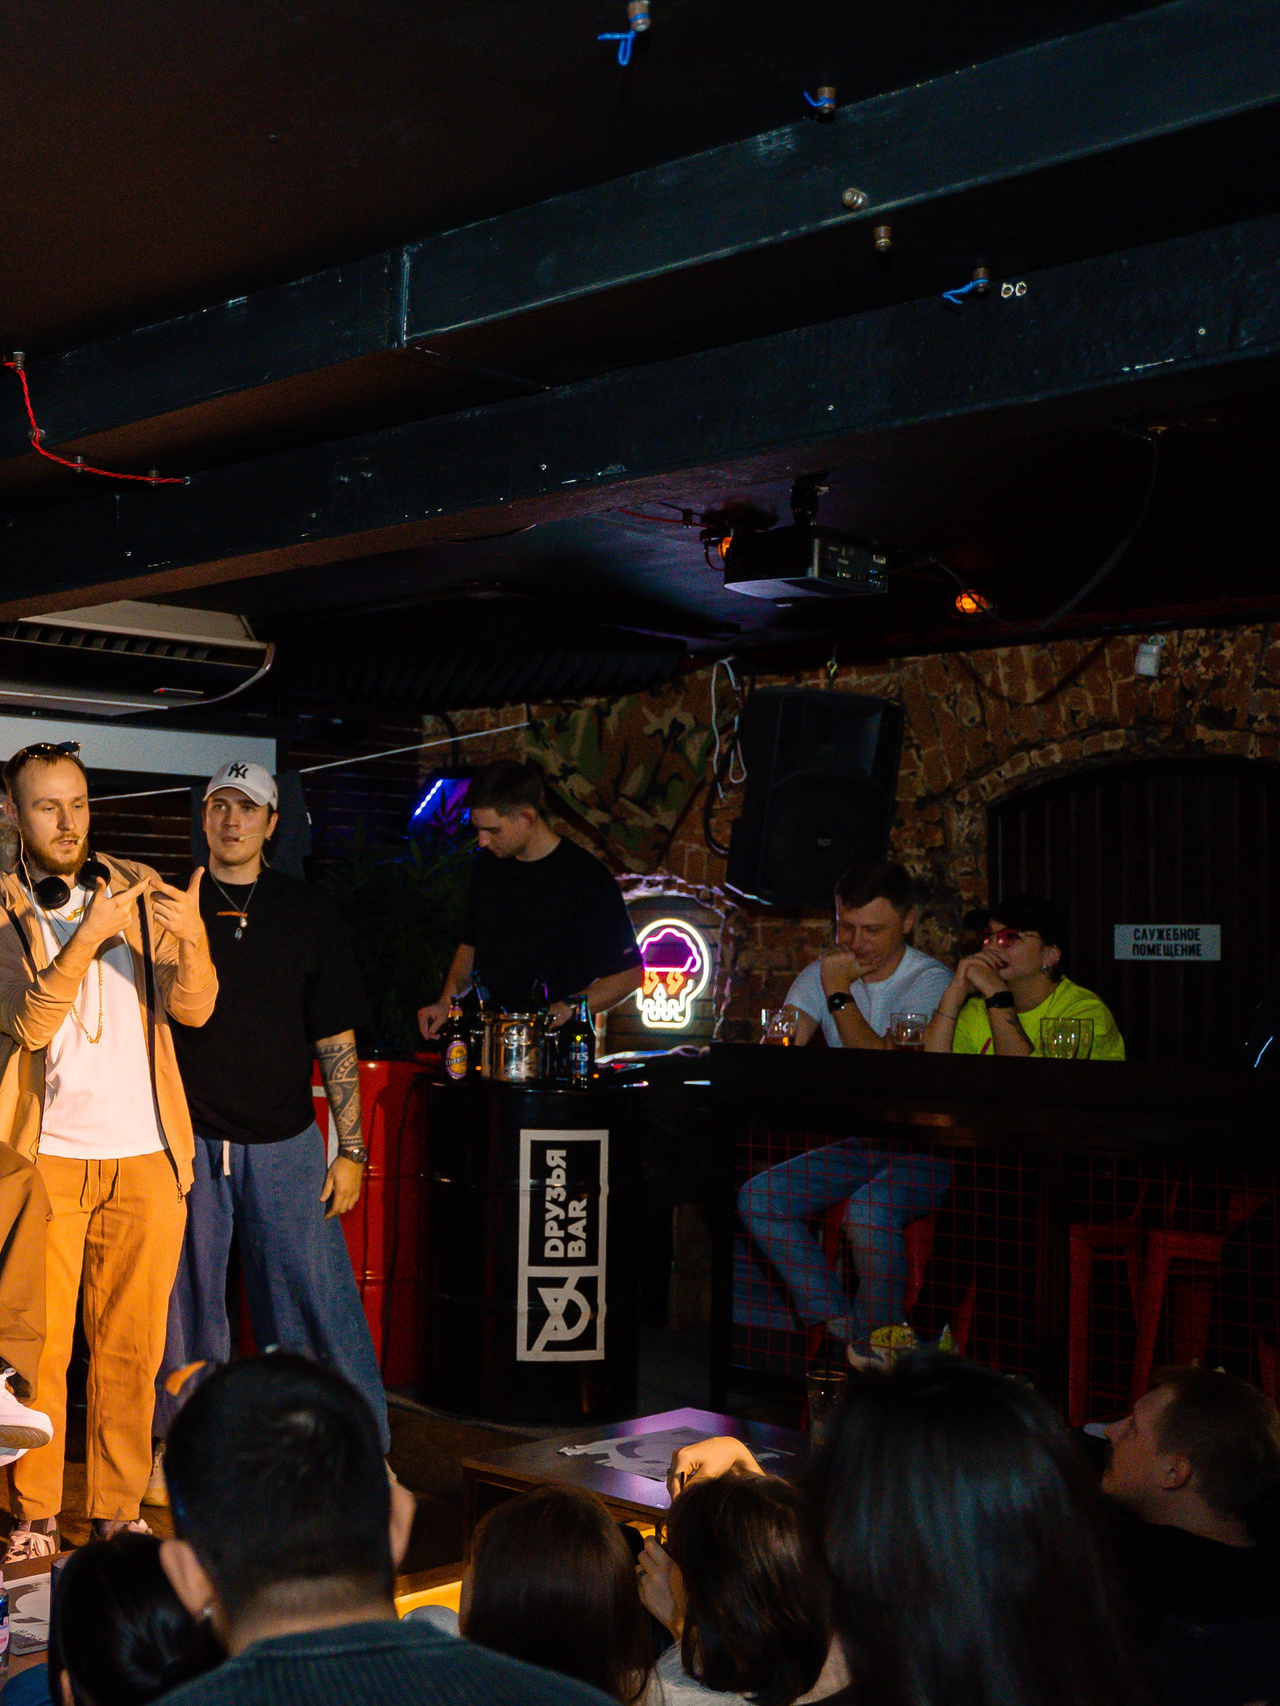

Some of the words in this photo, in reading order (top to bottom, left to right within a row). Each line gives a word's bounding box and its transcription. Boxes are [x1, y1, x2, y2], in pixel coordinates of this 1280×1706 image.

[1133, 928, 1201, 941] СЛУЖЕБНОЕ
[1132, 943, 1202, 957] ПОМЕЩЕНИЕ
[567, 1198, 587, 1258] BAR
